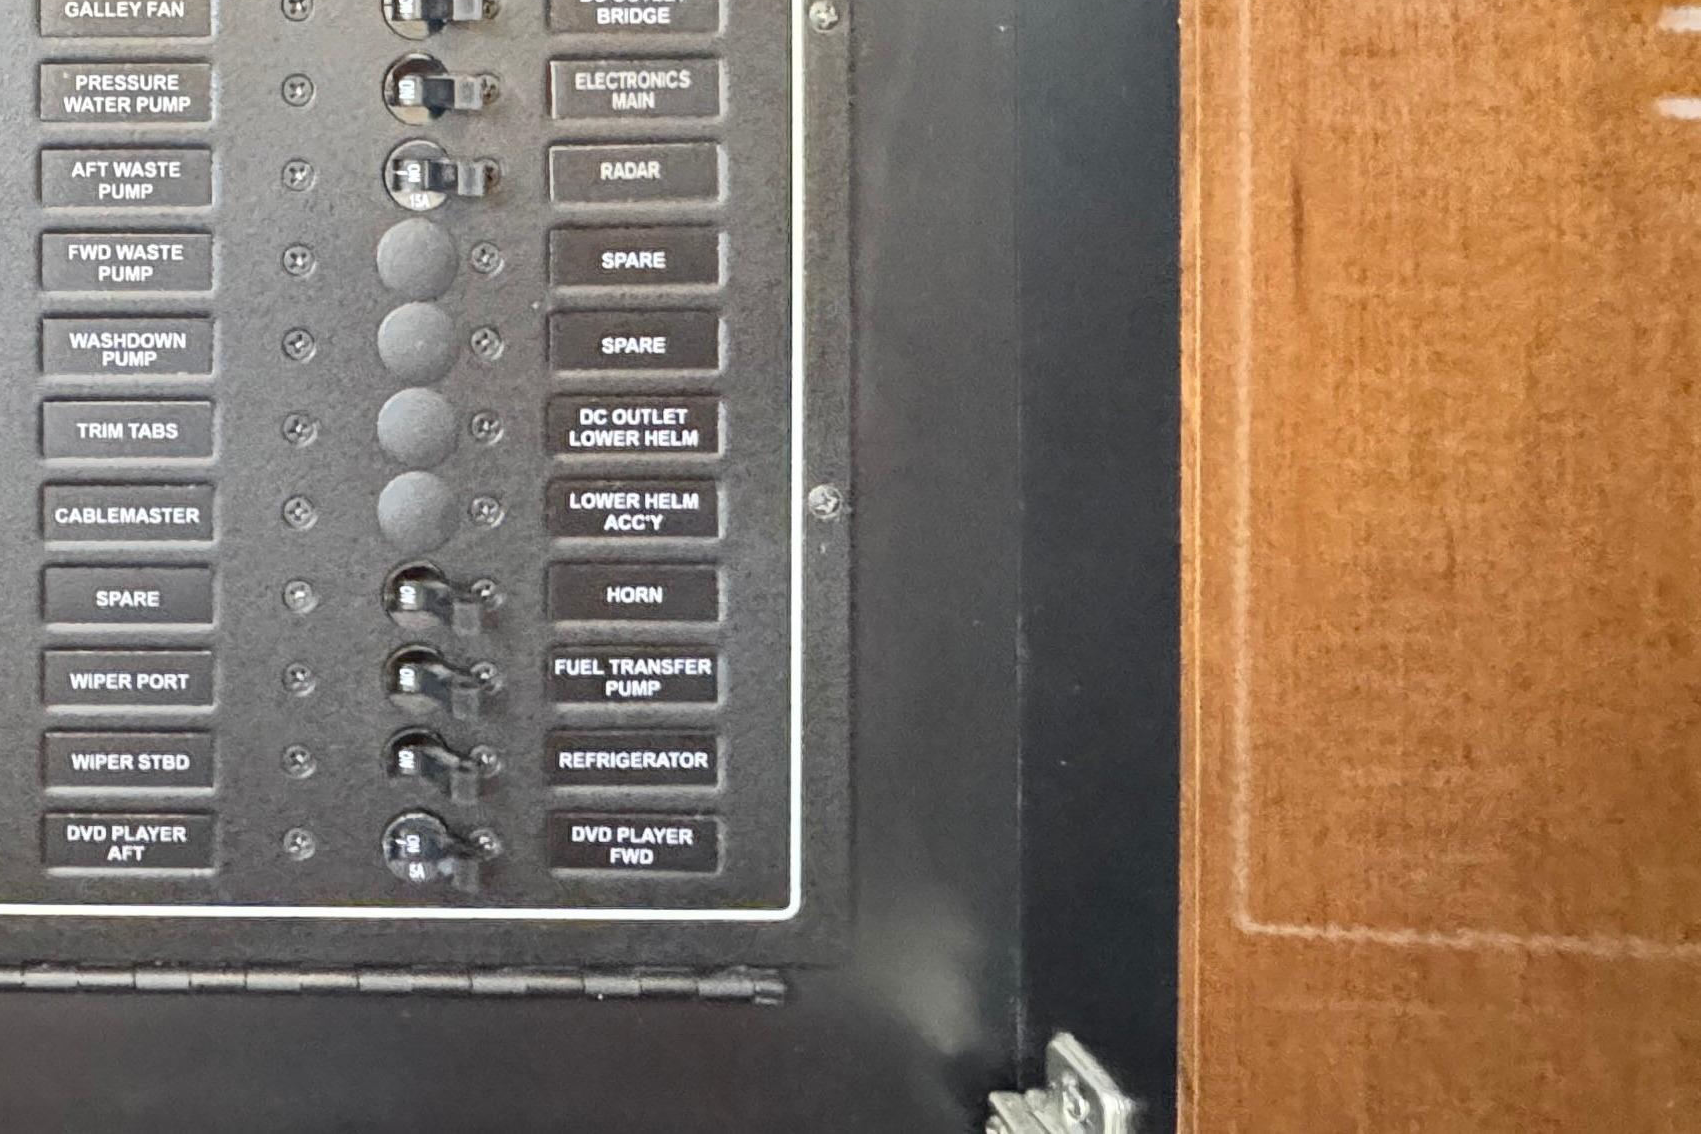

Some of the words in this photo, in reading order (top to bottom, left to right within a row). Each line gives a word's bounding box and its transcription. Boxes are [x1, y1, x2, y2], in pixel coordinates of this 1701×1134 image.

[64, 1, 142, 18] GALLEY
[146, 1, 185, 18] FAN
[597, 7, 670, 25] BRIDGE
[75, 74, 179, 91] PRESSURE
[575, 70, 691, 91] ELECTRONICS
[63, 96, 131, 113] WATER
[136, 96, 191, 113] PUMP
[612, 92, 655, 110] MAIN
[71, 162, 109, 178] AFT
[112, 162, 181, 178] WASTE
[600, 161, 660, 180] RADAR
[98, 184, 153, 200] PUMP
[601, 252, 666, 269] SPARE
[69, 332, 186, 349] WASHDOWN
[102, 350, 157, 367] PUMP
[579, 408, 608, 426] DC
[611, 408, 689, 426] OUTLET
[76, 422, 124, 439] TRIM
[127, 422, 179, 439] TABS
[569, 430, 640, 447] LOWER
[644, 430, 699, 447] HELM
[54, 506, 199, 525] CABLEMASTER
[606, 586, 663, 604] HORN
[554, 658, 605, 676] FUEL
[608, 658, 712, 676] TRANSFER
[69, 672, 133, 691] WIPER
[136, 672, 190, 691] PORT
[605, 680, 662, 696] PUMP
[559, 752, 708, 769] REFRIGERATOR
[66, 824, 107, 842] DVD
[111, 824, 187, 842] PLAYER
[571, 826, 613, 845] DVD
[616, 826, 694, 845] PLAYER
[107, 844, 145, 862] AFT
[609, 848, 654, 865] FWD
